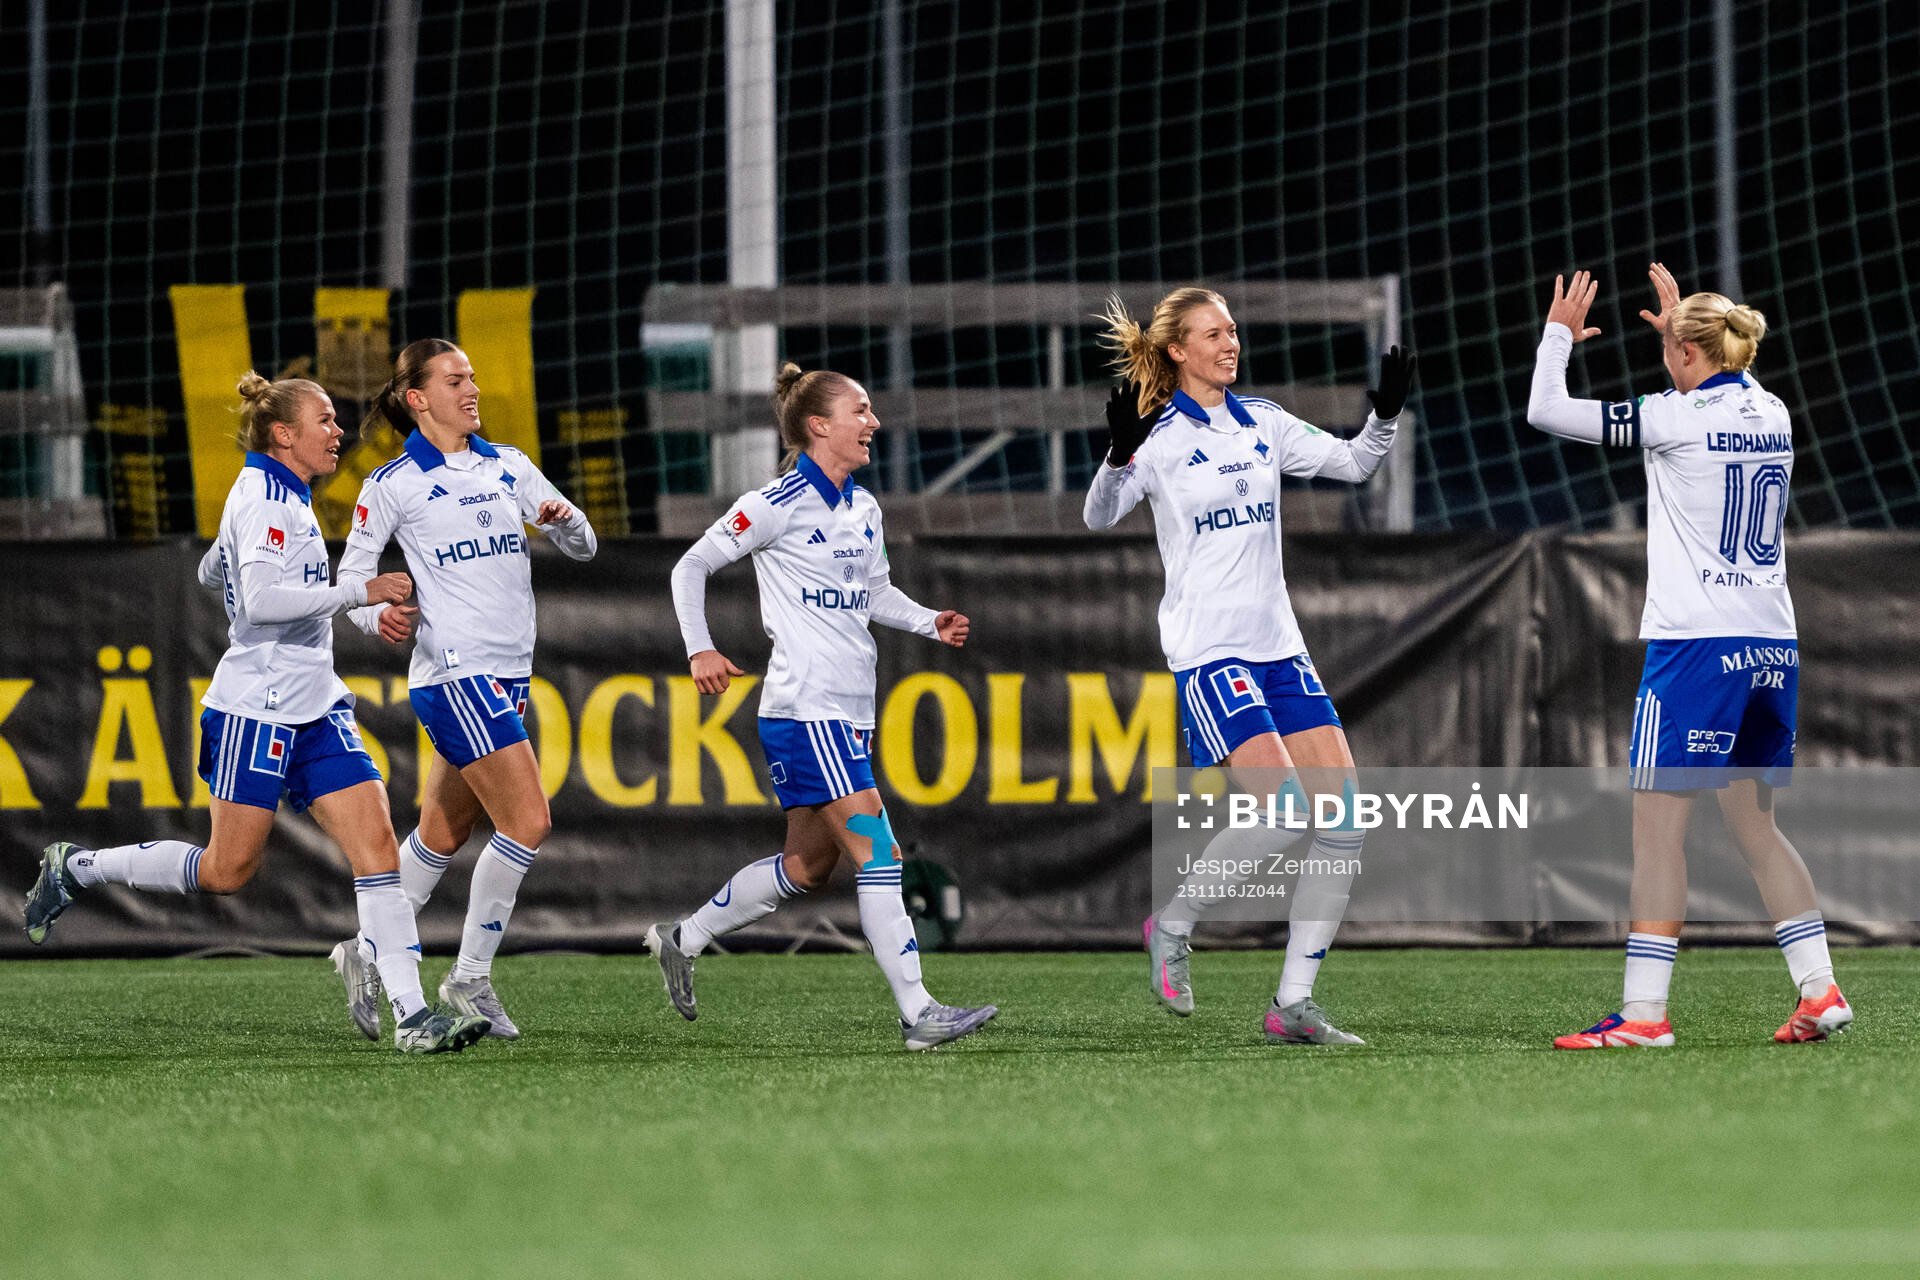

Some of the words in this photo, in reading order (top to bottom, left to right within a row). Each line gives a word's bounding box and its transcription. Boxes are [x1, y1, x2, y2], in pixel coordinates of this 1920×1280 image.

[1707, 432, 1791, 453] LEIDHAMMA
[1218, 462, 1254, 474] stadium
[459, 493, 500, 506] stadium
[1720, 464, 1788, 565] 10
[833, 549, 864, 558] stadium
[76, 645, 212, 809] Ä
[1687, 729, 1714, 742] pre
[1687, 742, 1720, 753] zero
